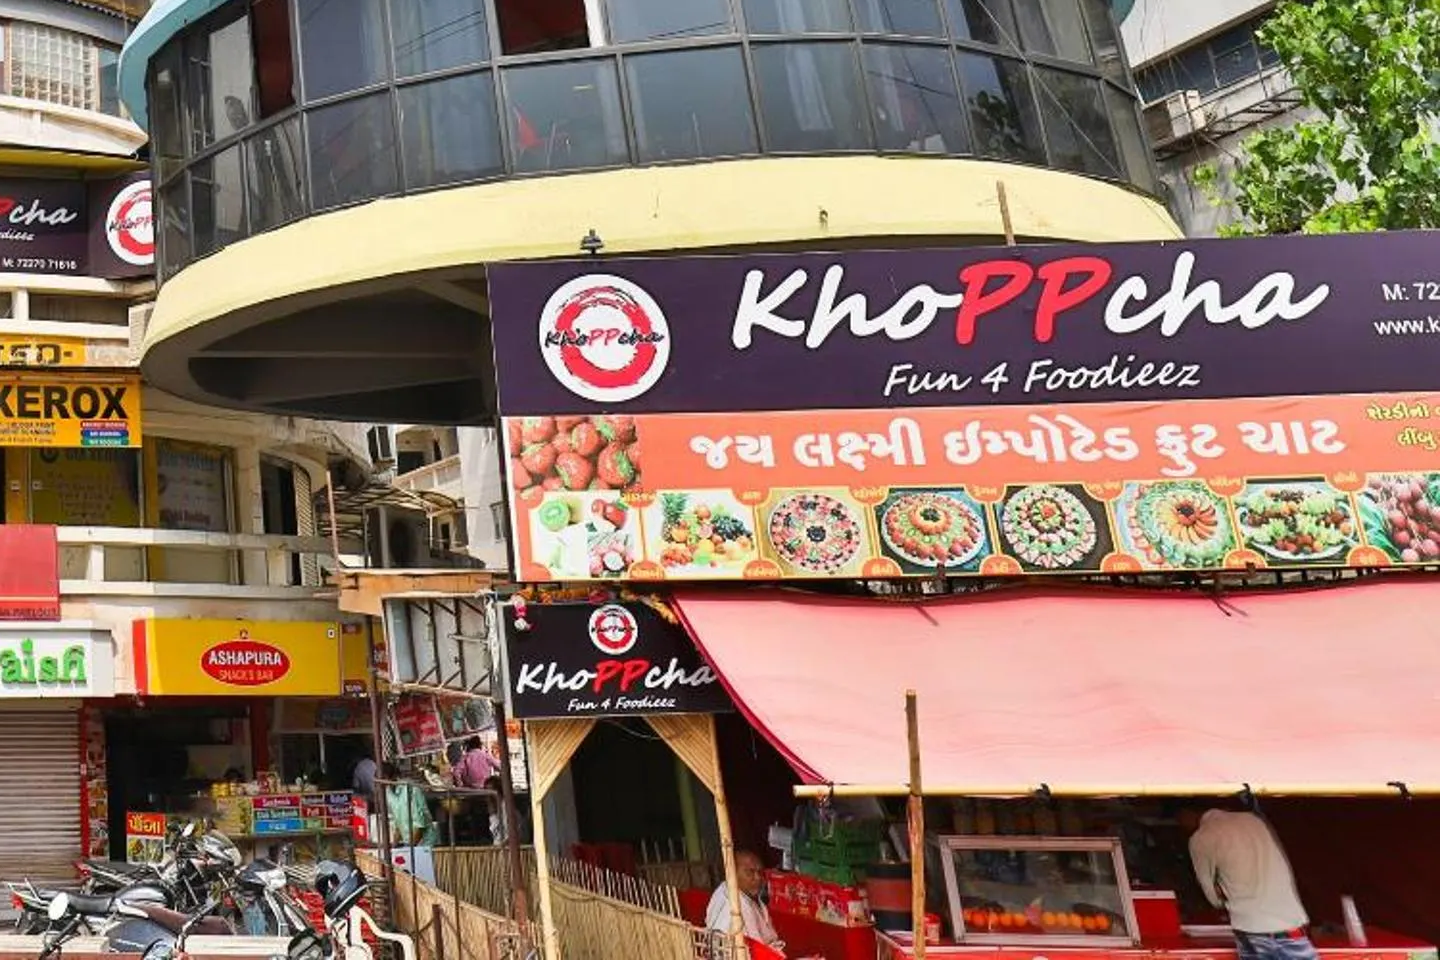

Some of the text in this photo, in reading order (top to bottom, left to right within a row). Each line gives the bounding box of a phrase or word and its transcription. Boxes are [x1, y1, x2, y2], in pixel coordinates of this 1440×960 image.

[732, 251, 1330, 349] KhoPPcha
[883, 354, 1201, 397] Fun 4 Foodieez
[690, 434, 776, 470] જય
[1237, 419, 1348, 456] ચાટ
[208, 650, 282, 666] ASHAPURA
[516, 657, 718, 697] KhoPPcha
[567, 698, 599, 713] Fun
